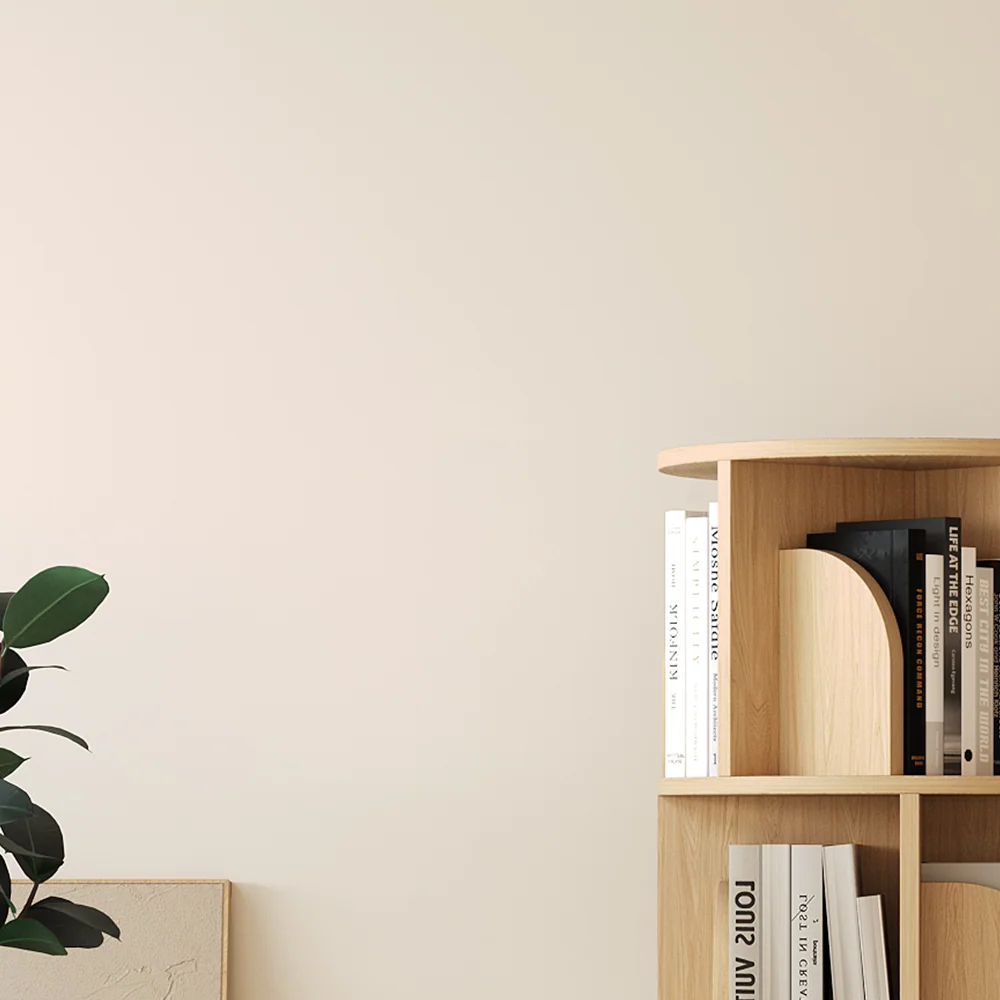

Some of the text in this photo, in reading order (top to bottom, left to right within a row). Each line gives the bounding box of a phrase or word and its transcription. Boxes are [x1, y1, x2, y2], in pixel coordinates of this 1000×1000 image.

[948, 526, 958, 633] LIFE AT THE EDGE
[979, 578, 989, 617] BEST
[669, 604, 678, 680] KINFOLK
[932, 576, 940, 668] Light in design
[963, 575, 974, 649] Hexagons
[979, 620, 989, 653] CITY
[979, 678, 989, 707] THE
[979, 711, 989, 763] WORLD
